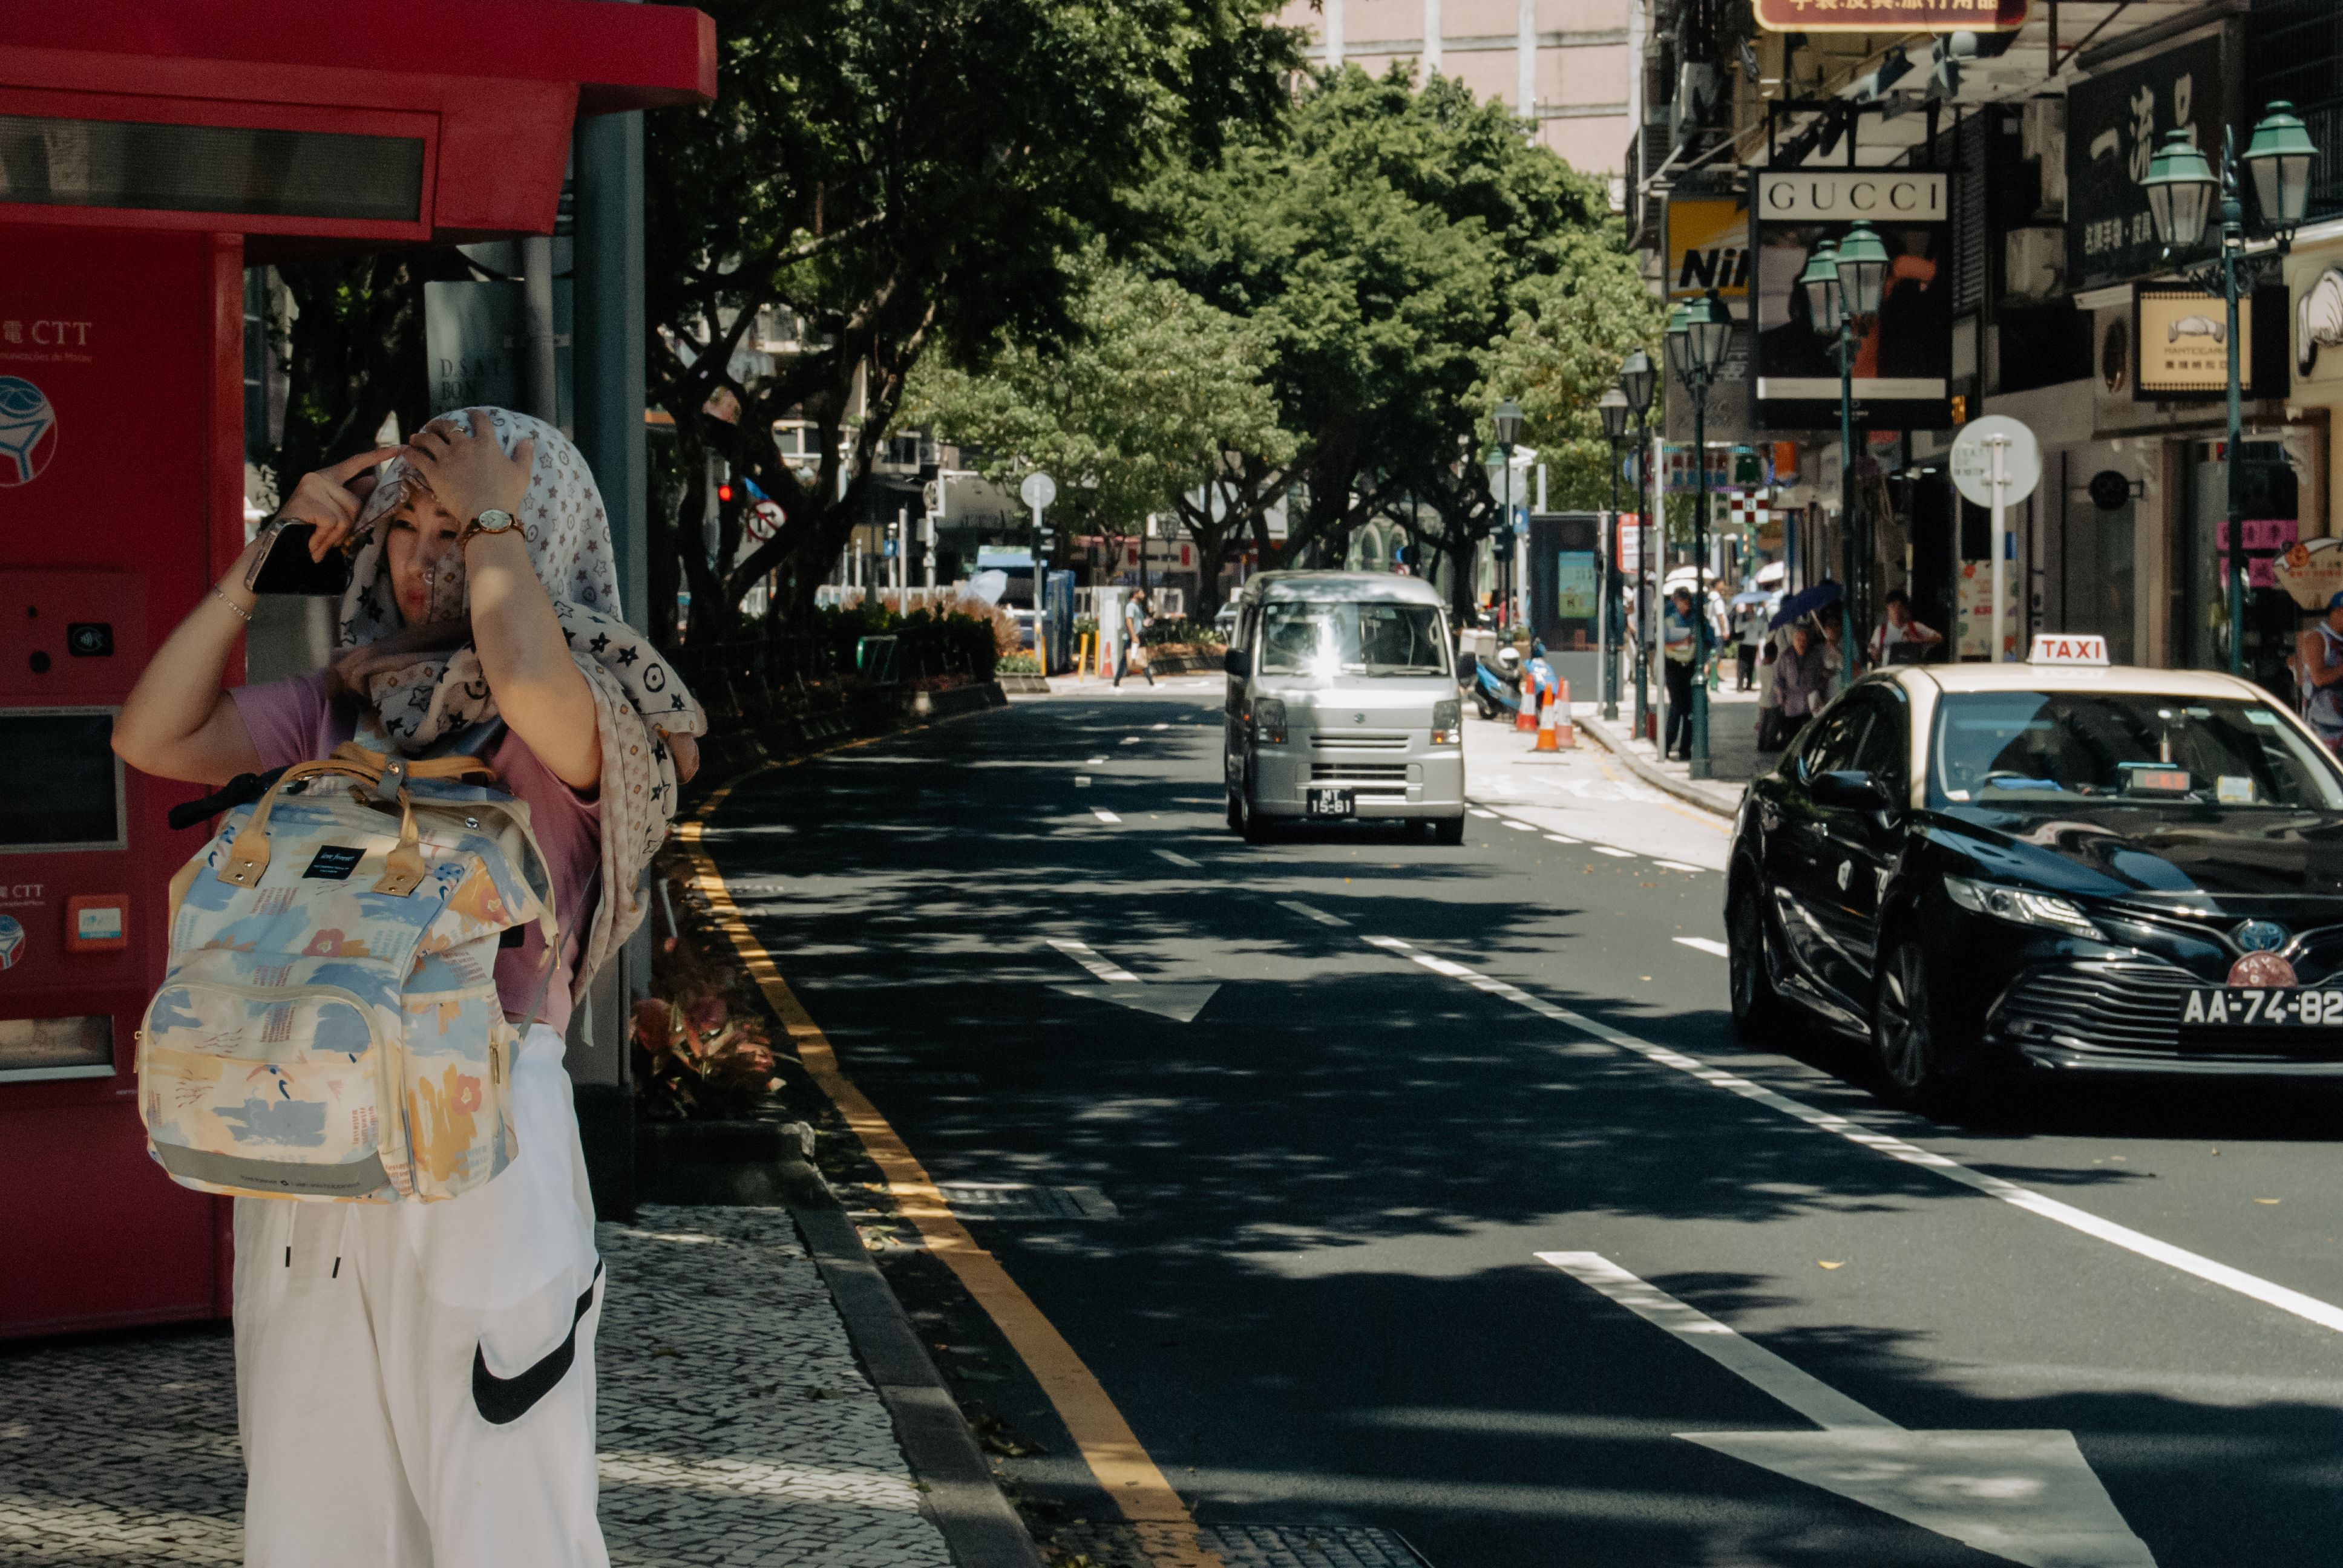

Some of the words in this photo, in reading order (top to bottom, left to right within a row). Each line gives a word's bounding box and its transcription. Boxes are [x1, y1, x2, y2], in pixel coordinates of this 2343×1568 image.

[1768, 181, 1937, 211] GUCCI
[31, 320, 92, 345] CTT
[2042, 640, 2100, 659] TAXI
[1322, 789, 1341, 802] MT
[1312, 799, 1351, 814] 15-61
[12, 884, 44, 898] CTT
[2184, 990, 2343, 1025] AA-74-82
